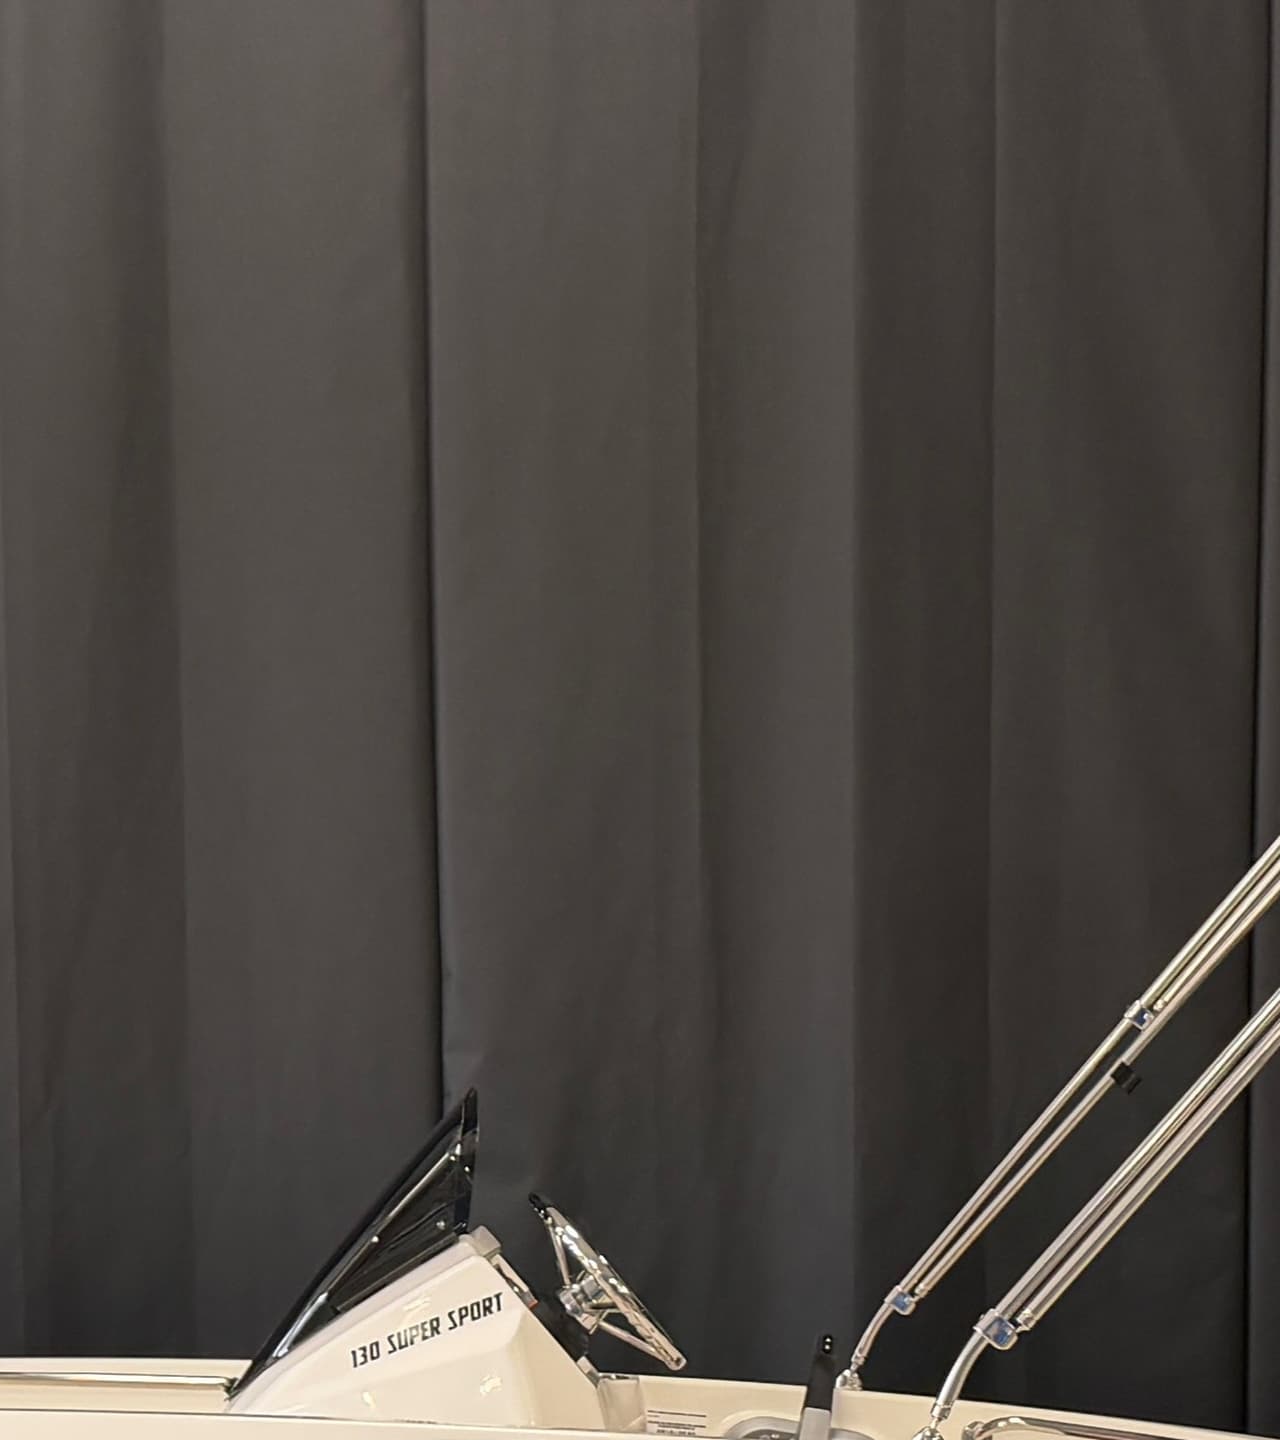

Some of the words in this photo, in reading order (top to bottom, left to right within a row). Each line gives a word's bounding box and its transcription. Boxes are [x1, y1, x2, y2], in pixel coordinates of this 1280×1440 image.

[351, 1341, 380, 1368] 130
[387, 1316, 440, 1354] SUPER
[448, 1292, 502, 1331] SPORT
